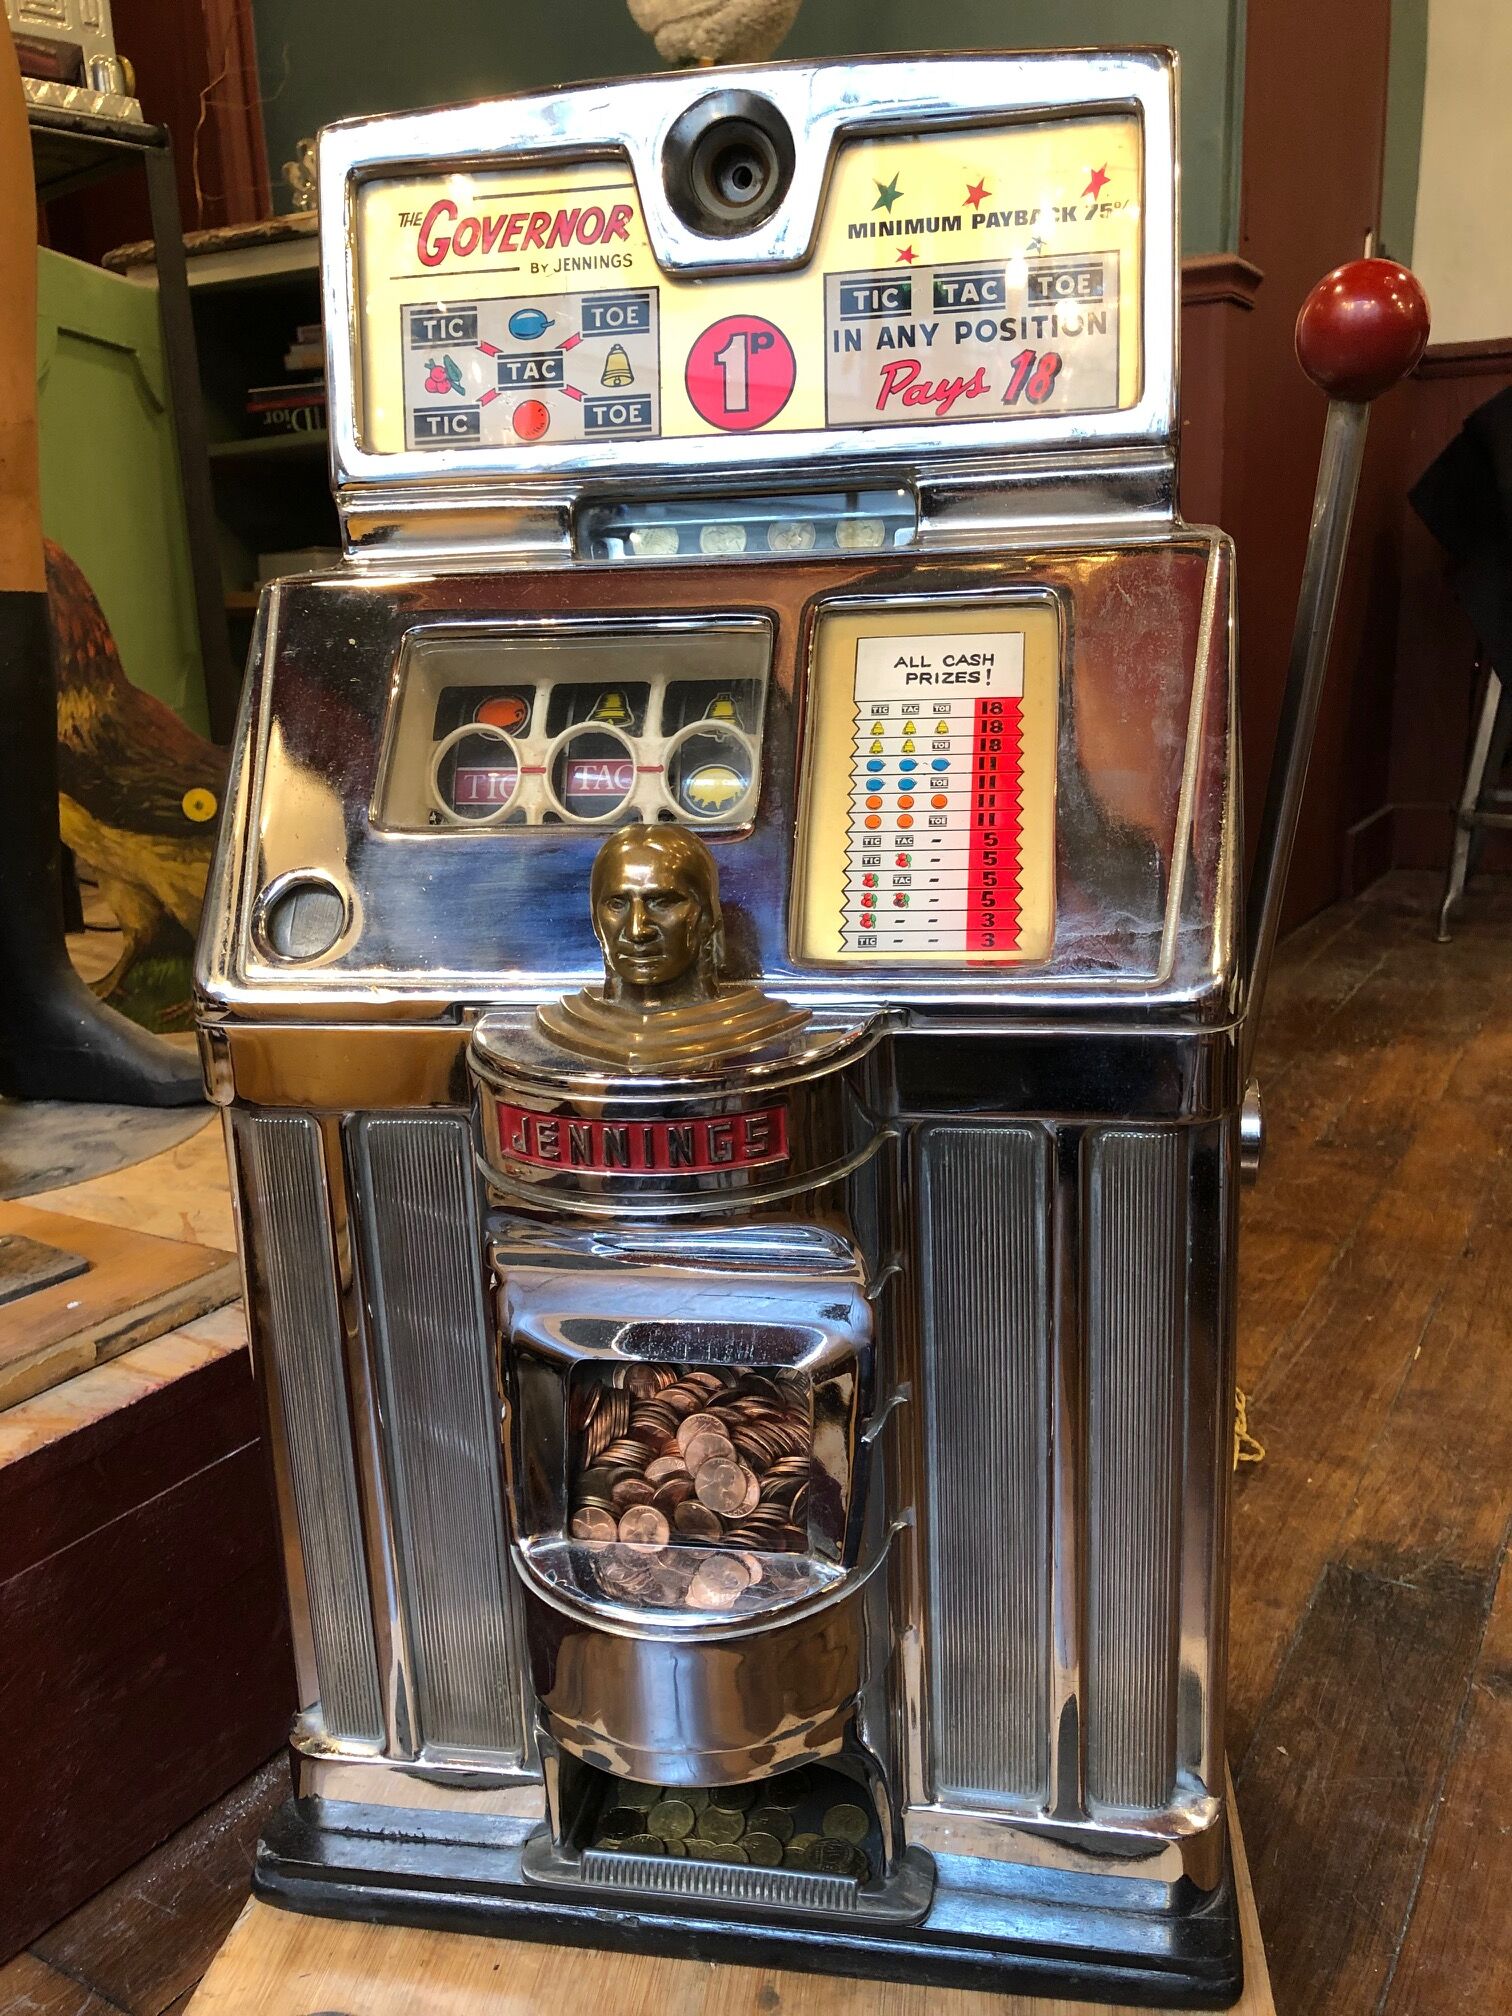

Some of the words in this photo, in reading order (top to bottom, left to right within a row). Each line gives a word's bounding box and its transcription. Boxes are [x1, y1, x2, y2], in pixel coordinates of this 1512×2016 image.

[399, 212, 423, 228] THE
[417, 199, 634, 267] GOVERNOR
[847, 214, 963, 239] MINIMUM
[553, 253, 633, 273] JENNINGS
[853, 288, 899, 311] TIC
[943, 280, 999, 303] TAC
[1037, 273, 1091, 296] TOE
[590, 305, 640, 327] TOE
[423, 319, 464, 338] TIC
[833, 328, 863, 353] IN
[876, 323, 939, 350] ANY
[954, 311, 1108, 345] POSITION
[506, 361, 557, 380] TAC
[875, 356, 990, 416] Pays
[1001, 348, 1063, 406] 18
[592, 404, 642, 425] TOE
[426, 415, 469, 434] TIC
[893, 655, 931, 669] ALL
[942, 653, 995, 667] CASH
[905, 668, 991, 686] PRIZES!
[872, 705, 889, 714] TIC
[902, 704, 919, 713] TAC
[981, 702, 1003, 715] 18
[981, 720, 1003, 734] 18
[980, 738, 1002, 752] 18
[574, 764, 632, 791] TAC
[864, 837, 881, 846] TIC
[895, 836, 913, 845] TAC
[983, 832, 998, 847] 5
[863, 856, 880, 865] TIC
[983, 851, 998, 866] 5
[893, 876, 911, 885] TAC
[982, 871, 997, 887] 5
[981, 891, 996, 908] 5
[981, 913, 995, 928] 3
[859, 937, 876, 946] TIC
[980, 933, 995, 948] 3
[511, 1112, 769, 1168] JENNINGS
